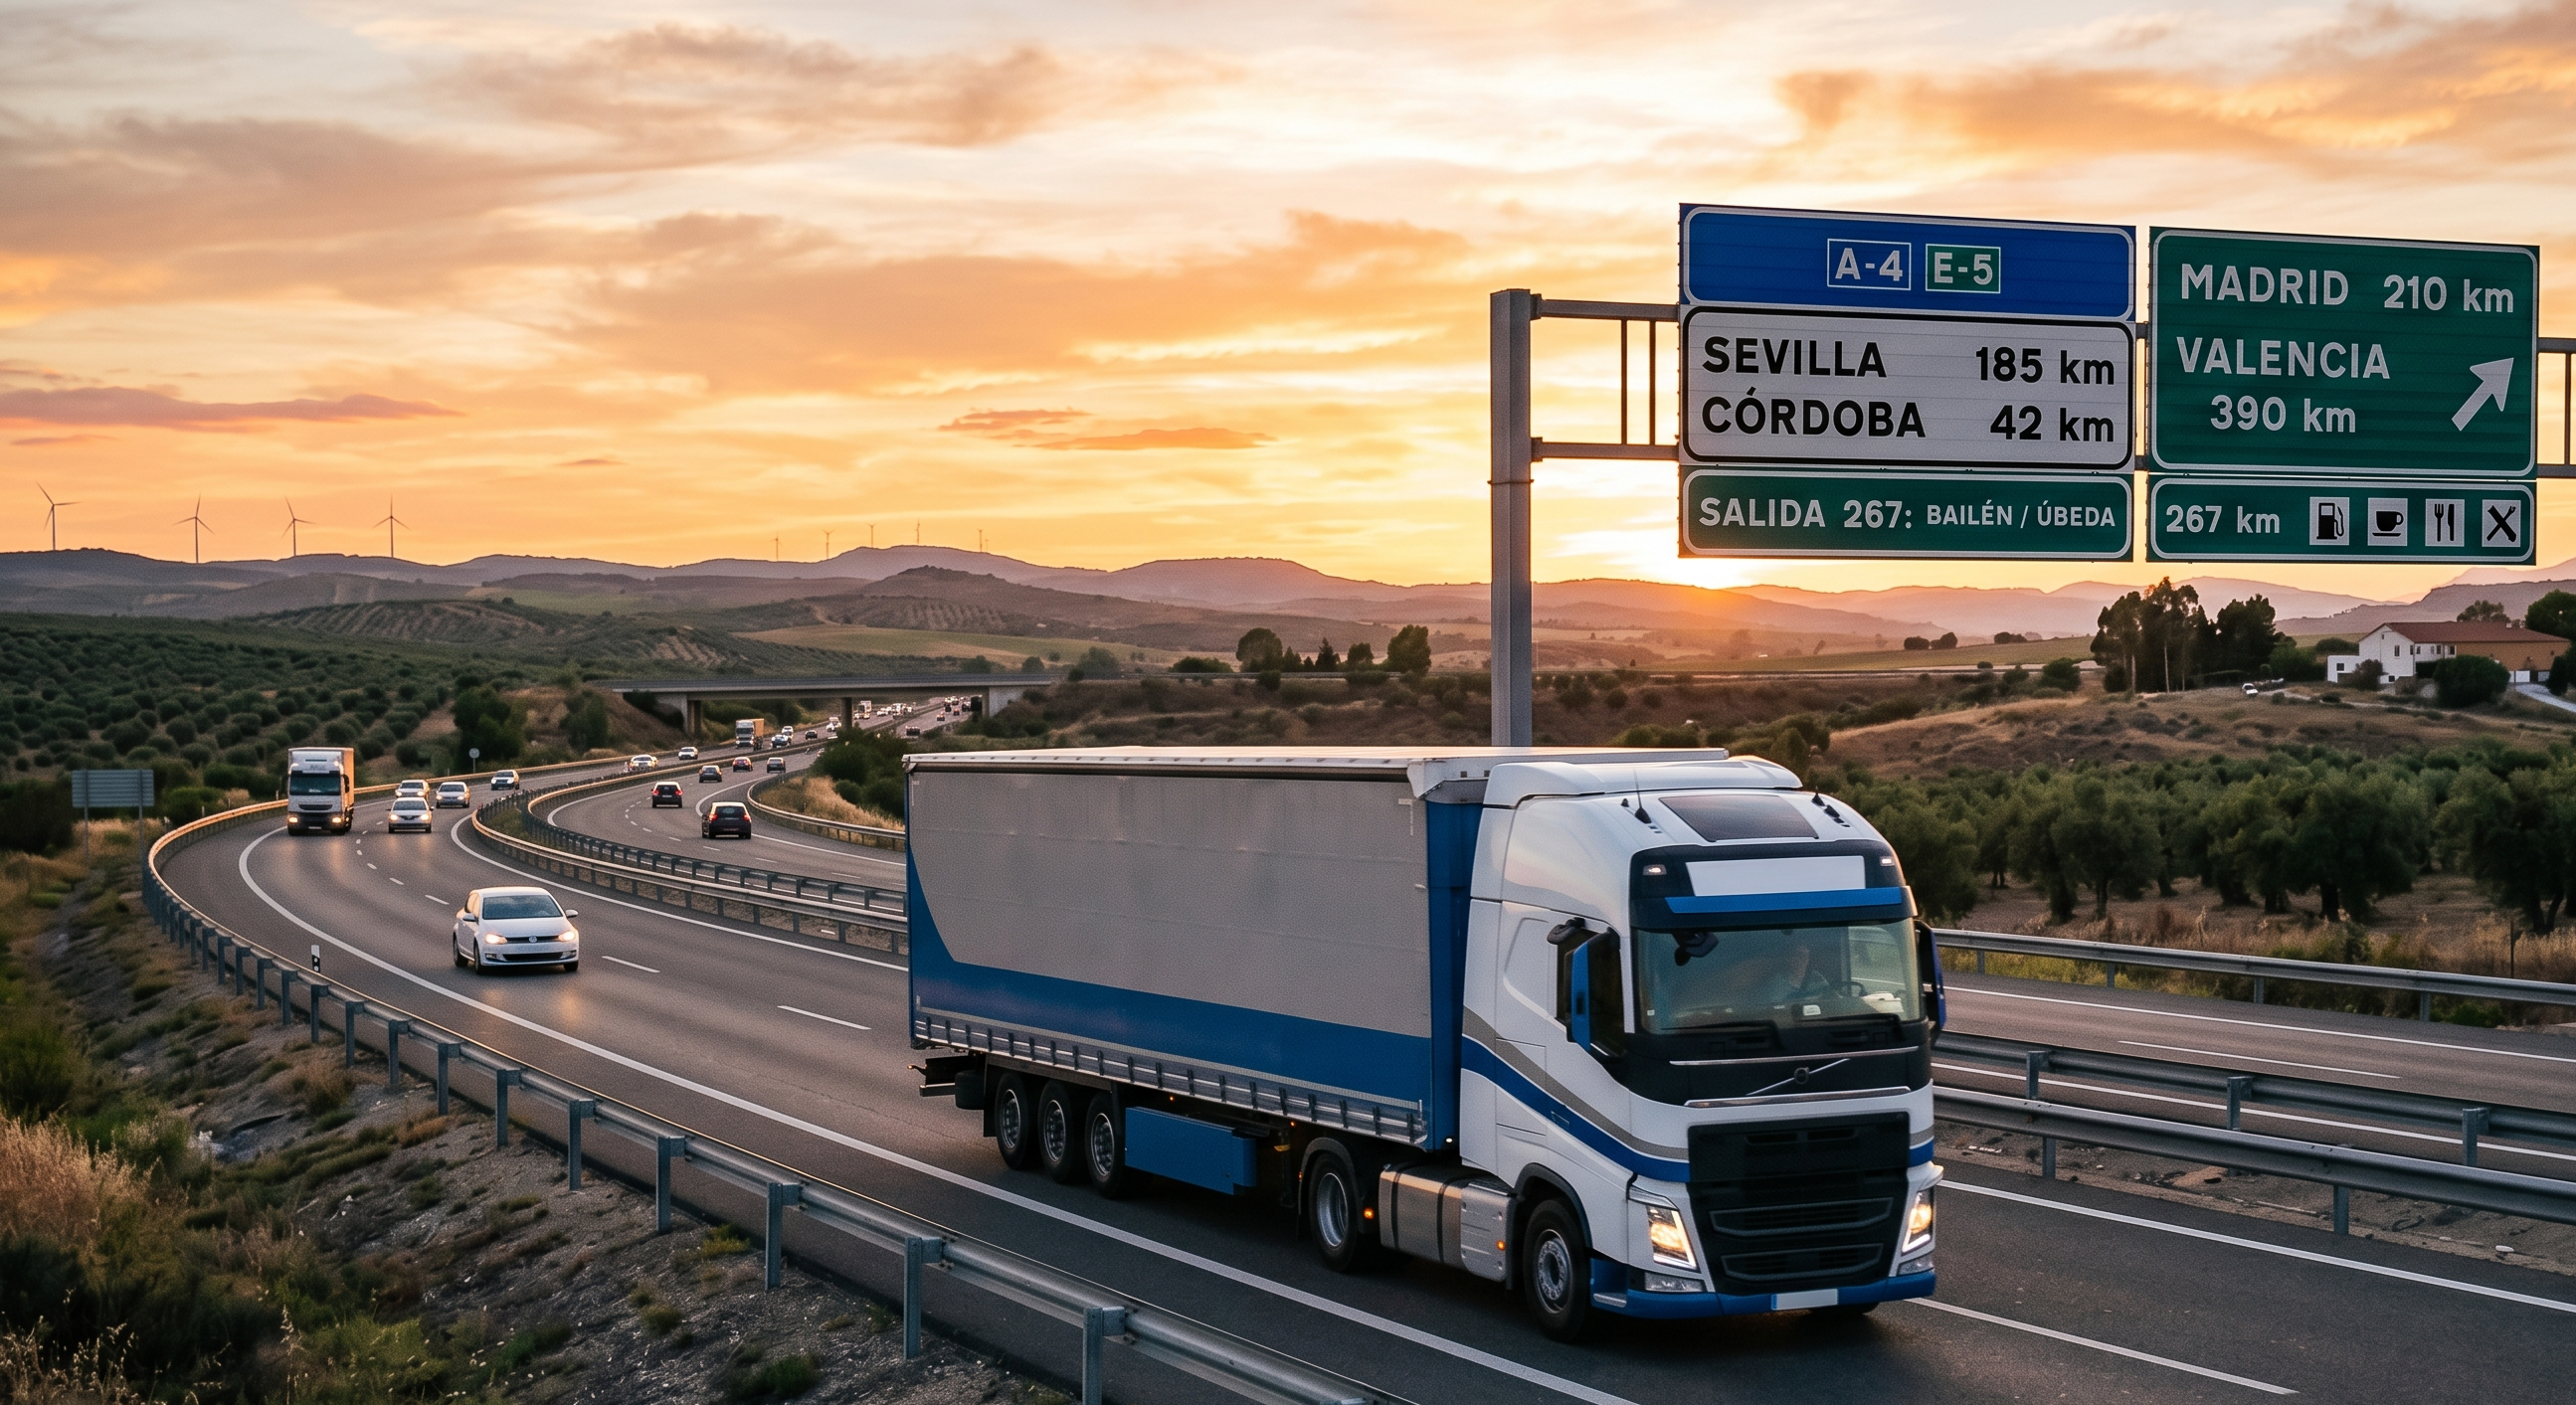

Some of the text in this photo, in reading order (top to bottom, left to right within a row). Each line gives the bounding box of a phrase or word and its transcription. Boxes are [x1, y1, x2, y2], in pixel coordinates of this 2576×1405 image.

[1835, 247, 1904, 282] A-4
[1933, 252, 1993, 285] E-5
[2181, 263, 2514, 313] MADRID 210 km
[1702, 336, 2115, 386] SEVILLA 185 km
[2176, 336, 2391, 380] VALENCIA
[1702, 386, 2115, 442] CÓRDOBA 42 km
[2210, 394, 2356, 434] 390 km
[1698, 496, 2116, 529] SALIDA 267: BAILÉN / ÚBEDA
[2165, 504, 2281, 534] 267 km
